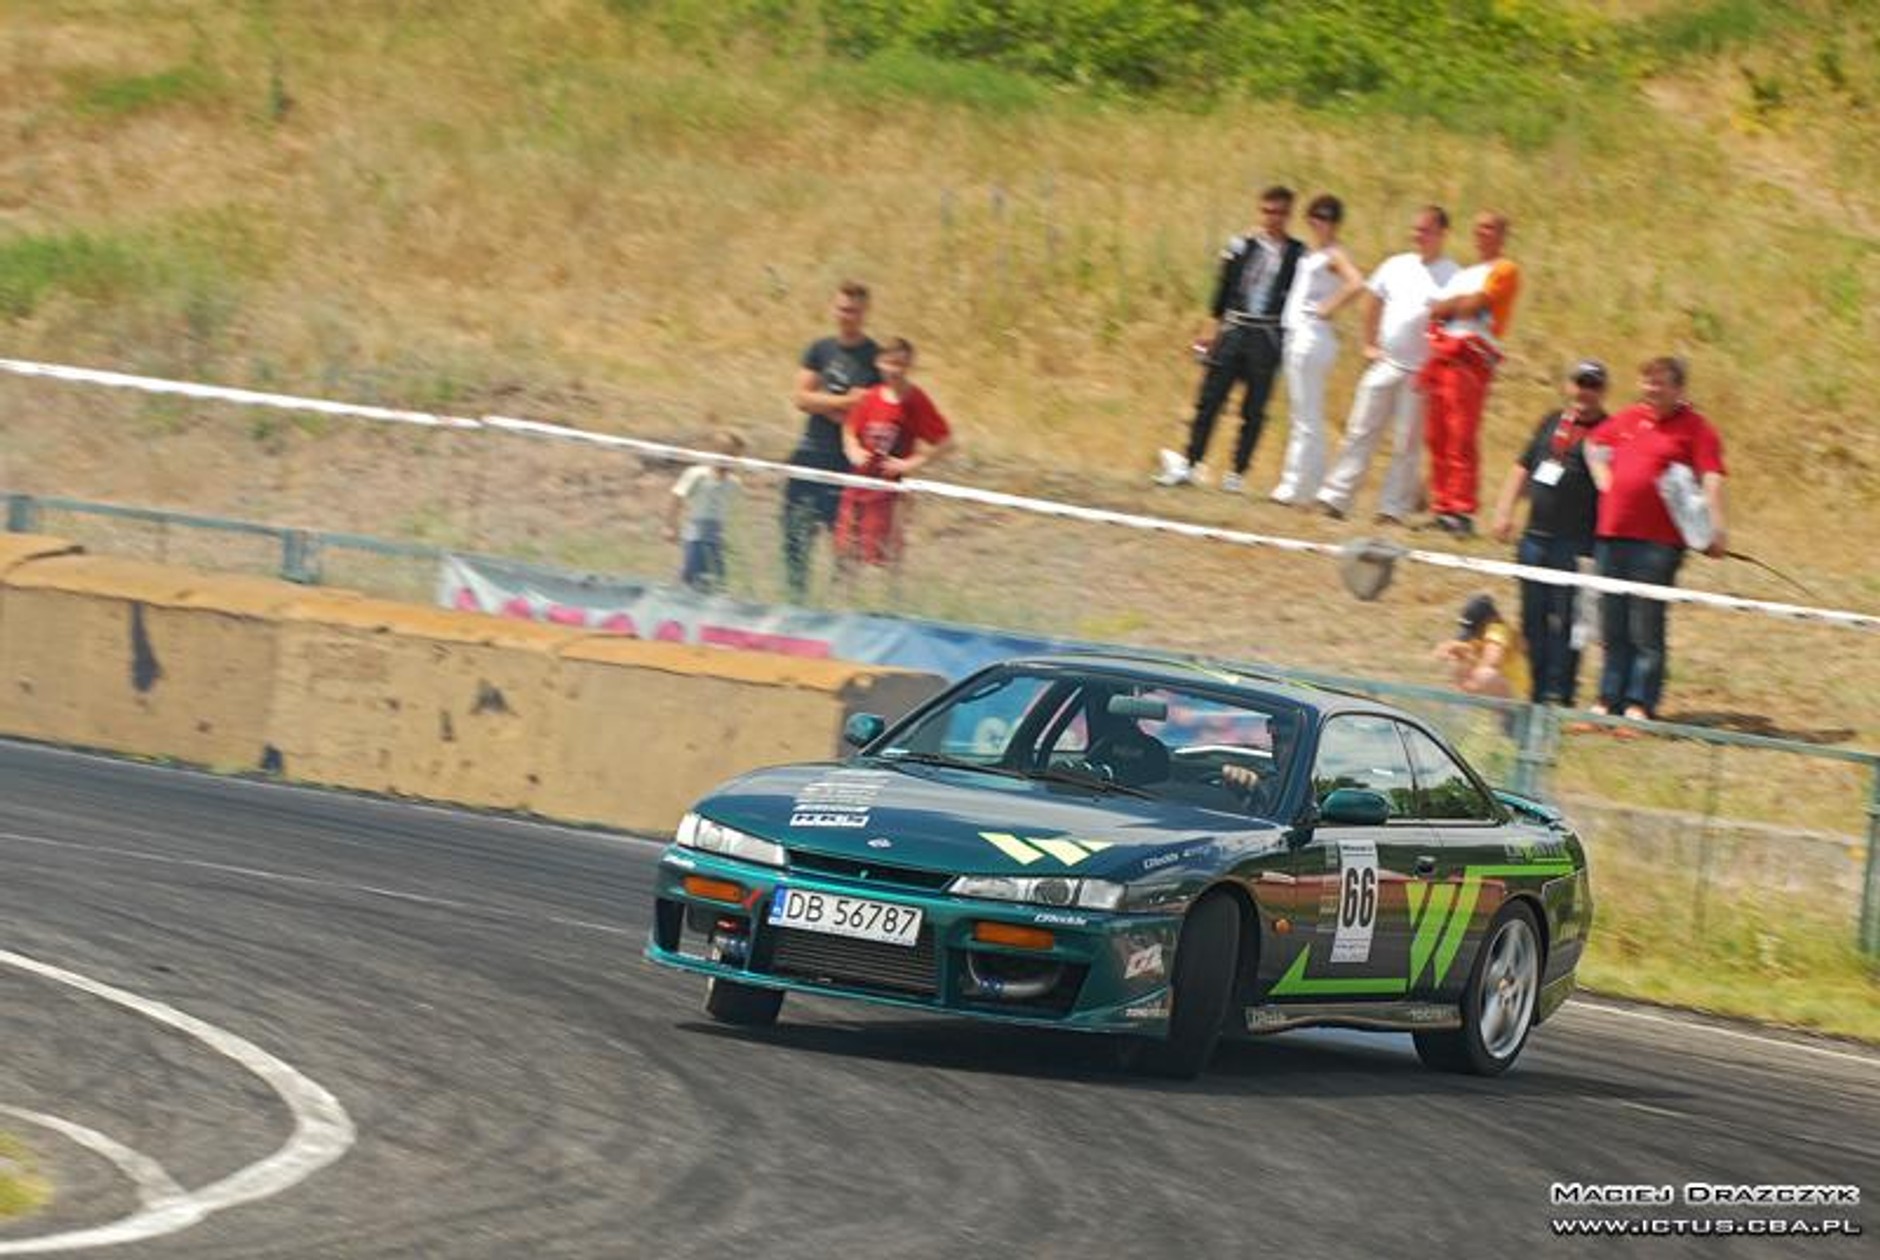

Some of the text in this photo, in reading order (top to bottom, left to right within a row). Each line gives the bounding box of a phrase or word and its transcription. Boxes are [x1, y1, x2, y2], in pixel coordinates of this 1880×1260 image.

[786, 893, 916, 936] DB 56787
[1343, 867, 1375, 927] 66
